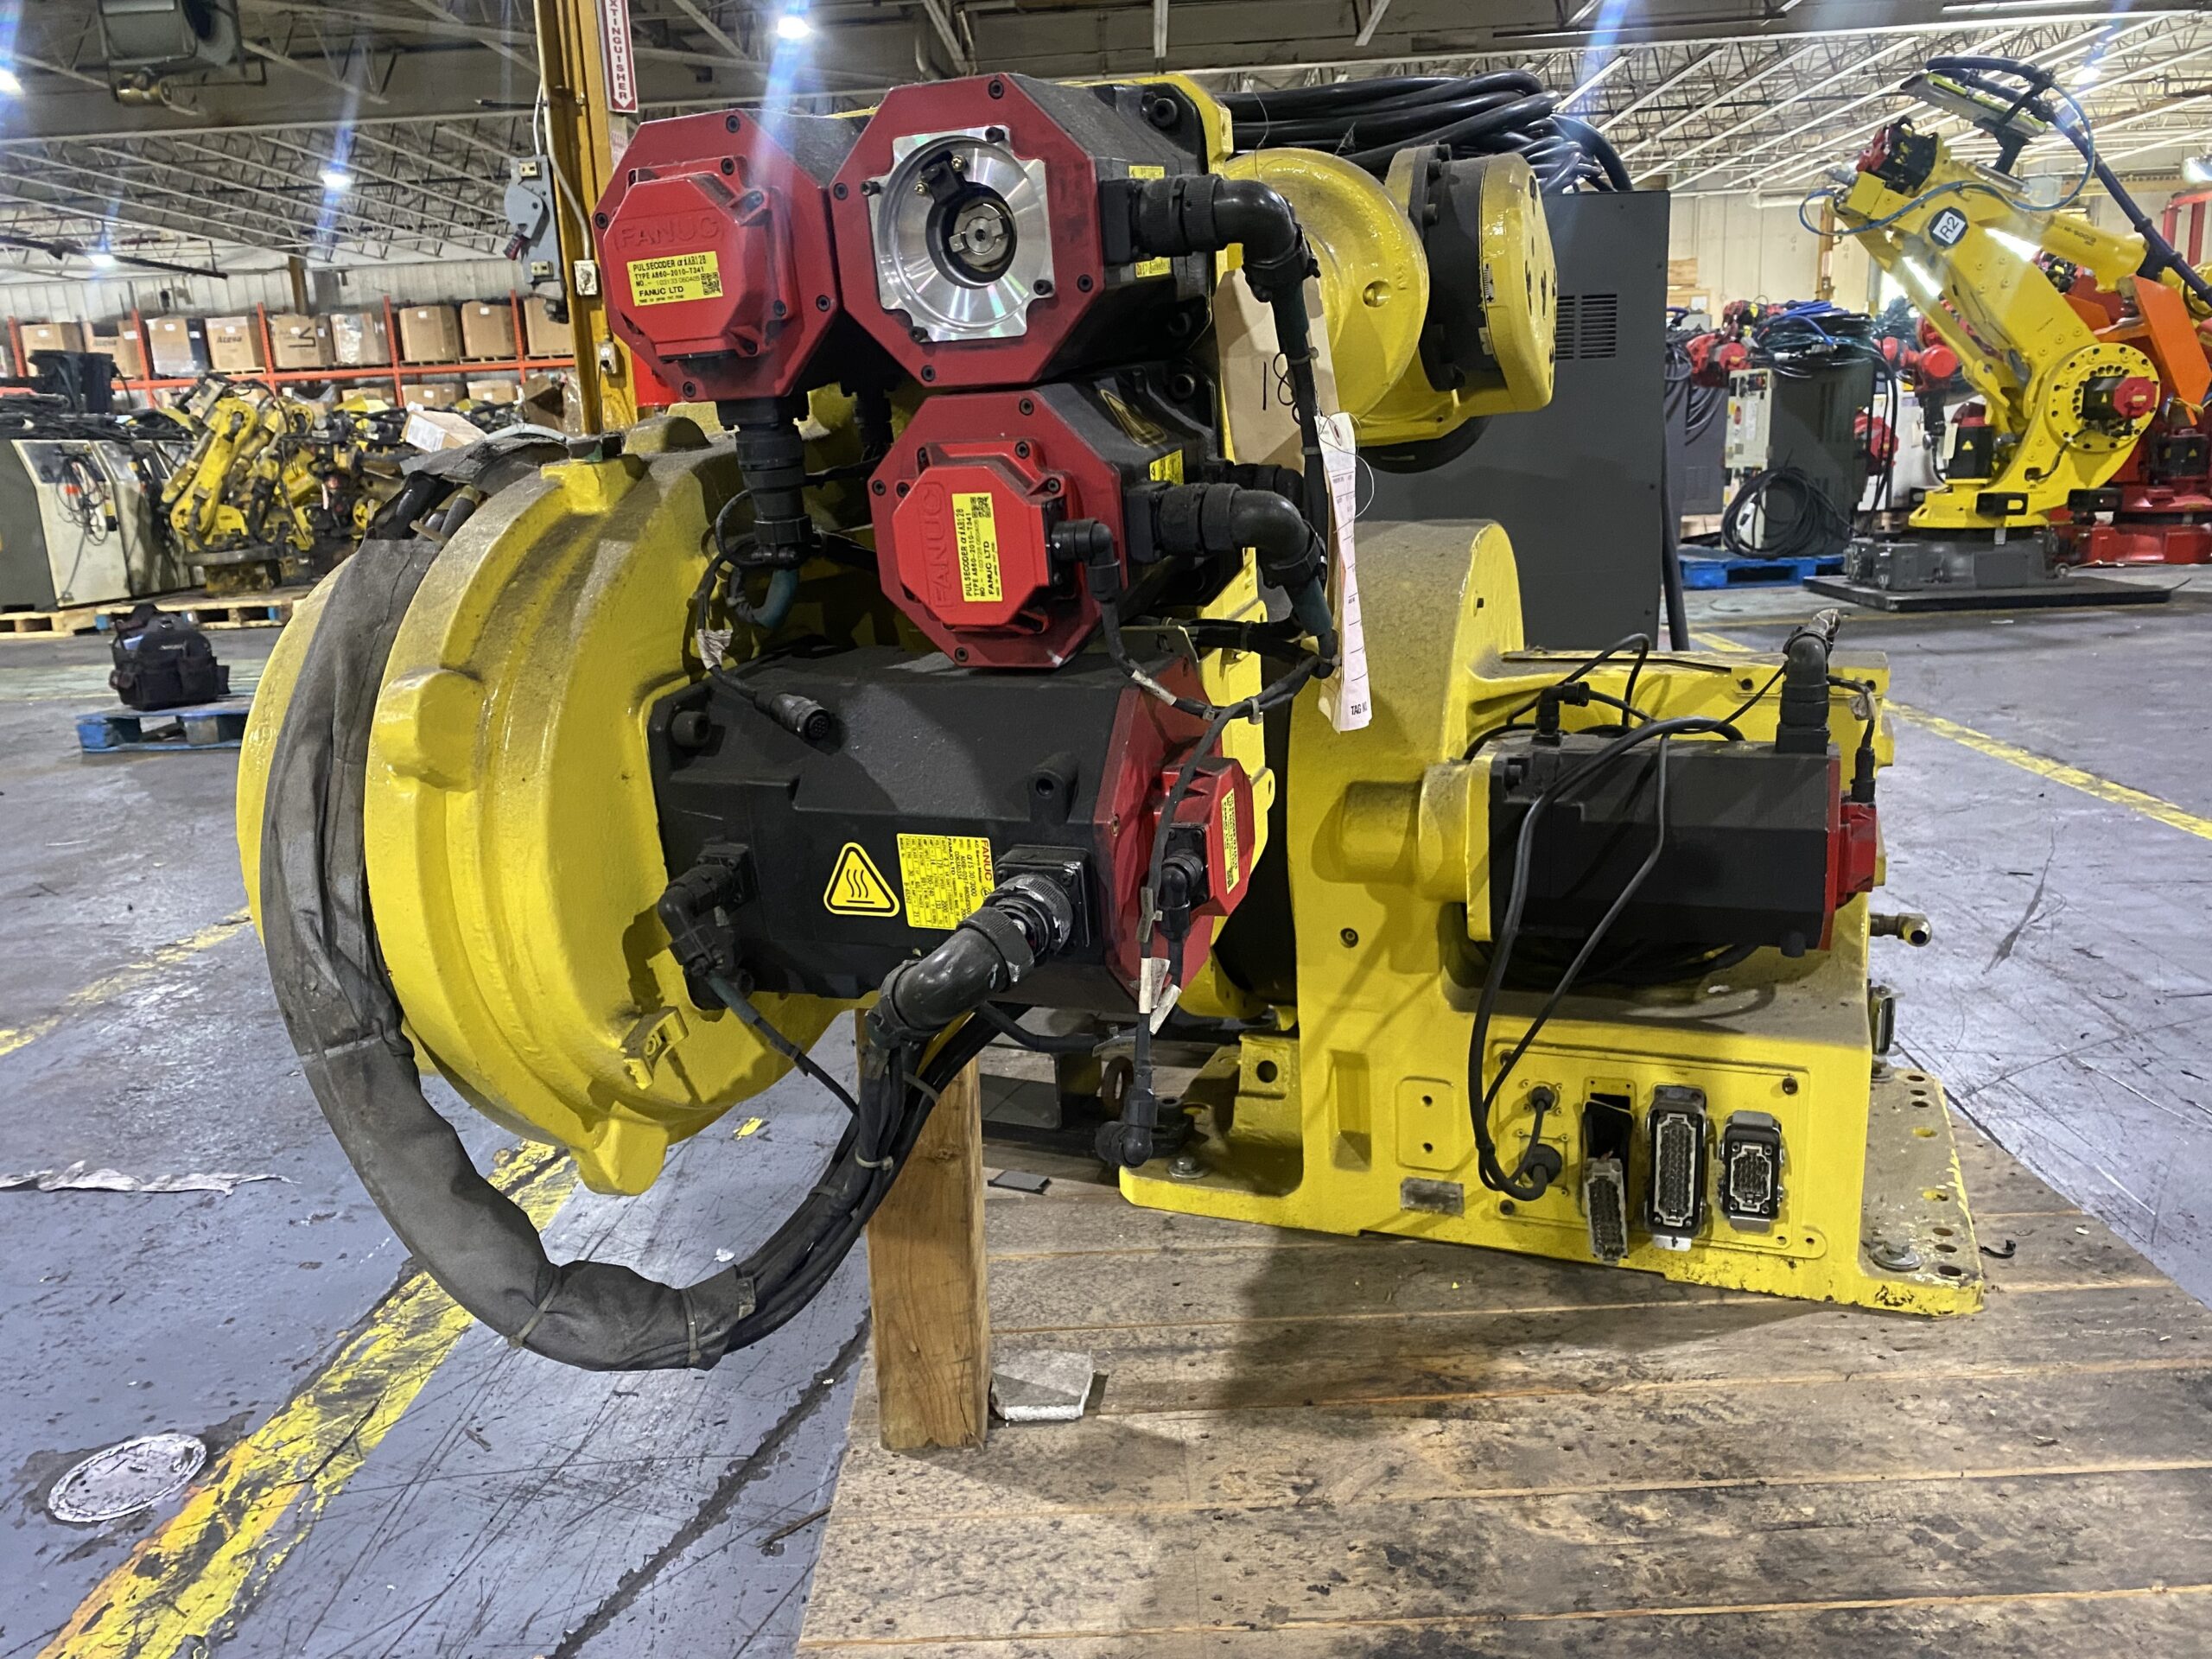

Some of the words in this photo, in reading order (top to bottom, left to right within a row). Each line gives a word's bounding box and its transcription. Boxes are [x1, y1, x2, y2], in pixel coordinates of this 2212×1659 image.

[622, 217, 719, 249] FANUC
[1940, 216, 1959, 238] R2
[633, 259, 676, 273] PULSECODER
[635, 271, 651, 280] TYPE
[639, 288, 666, 297] FANUC
[923, 487, 950, 601] FANUC
[982, 541, 991, 559] LTD
[961, 545, 972, 597] PULSECODER
[985, 563, 995, 595] FANUC
[1351, 704, 1362, 715] TAG
[981, 840, 992, 881] FANUC
